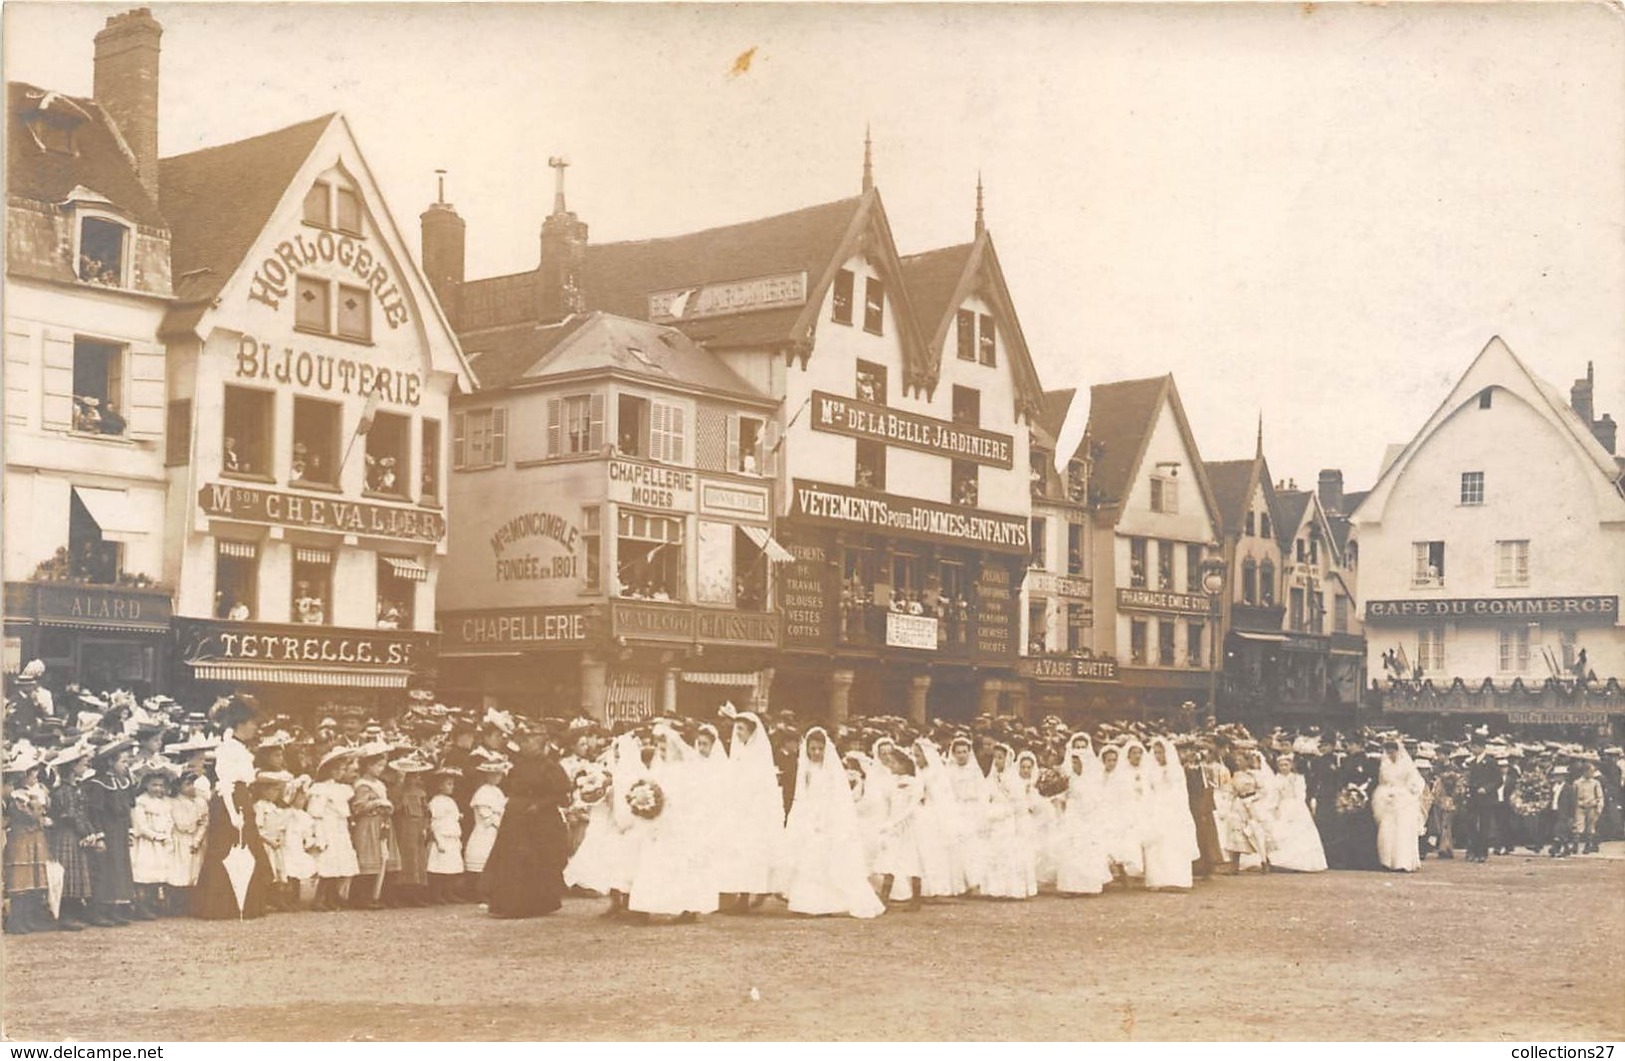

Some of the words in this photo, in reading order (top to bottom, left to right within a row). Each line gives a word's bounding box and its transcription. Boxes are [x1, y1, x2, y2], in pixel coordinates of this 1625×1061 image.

[249, 231, 409, 329] HORLOGERIE
[236, 334, 421, 406] BIJOUTERIE
[848, 408, 866, 430] DE
[869, 413, 886, 436] LA
[888, 415, 930, 445] BELLE
[609, 462, 693, 492] CHAPELLERIE
[632, 487, 674, 508] MODES
[266, 494, 437, 536] CHEVALIER
[799, 485, 889, 526] VÊTEMENTS
[912, 507, 963, 538] HOMMES
[970, 514, 1027, 546] ENFANTS
[552, 555, 577, 578] 1801
[71, 596, 141, 619] ALARD
[785, 595, 823, 608] BLOUSES
[1434, 601, 1467, 614] DU
[1474, 598, 1614, 614] COMMERCE
[462, 614, 585, 642] CHAPELLERIE
[788, 610, 820, 623] VESTES
[1077, 662, 1114, 678] BUVETTE
